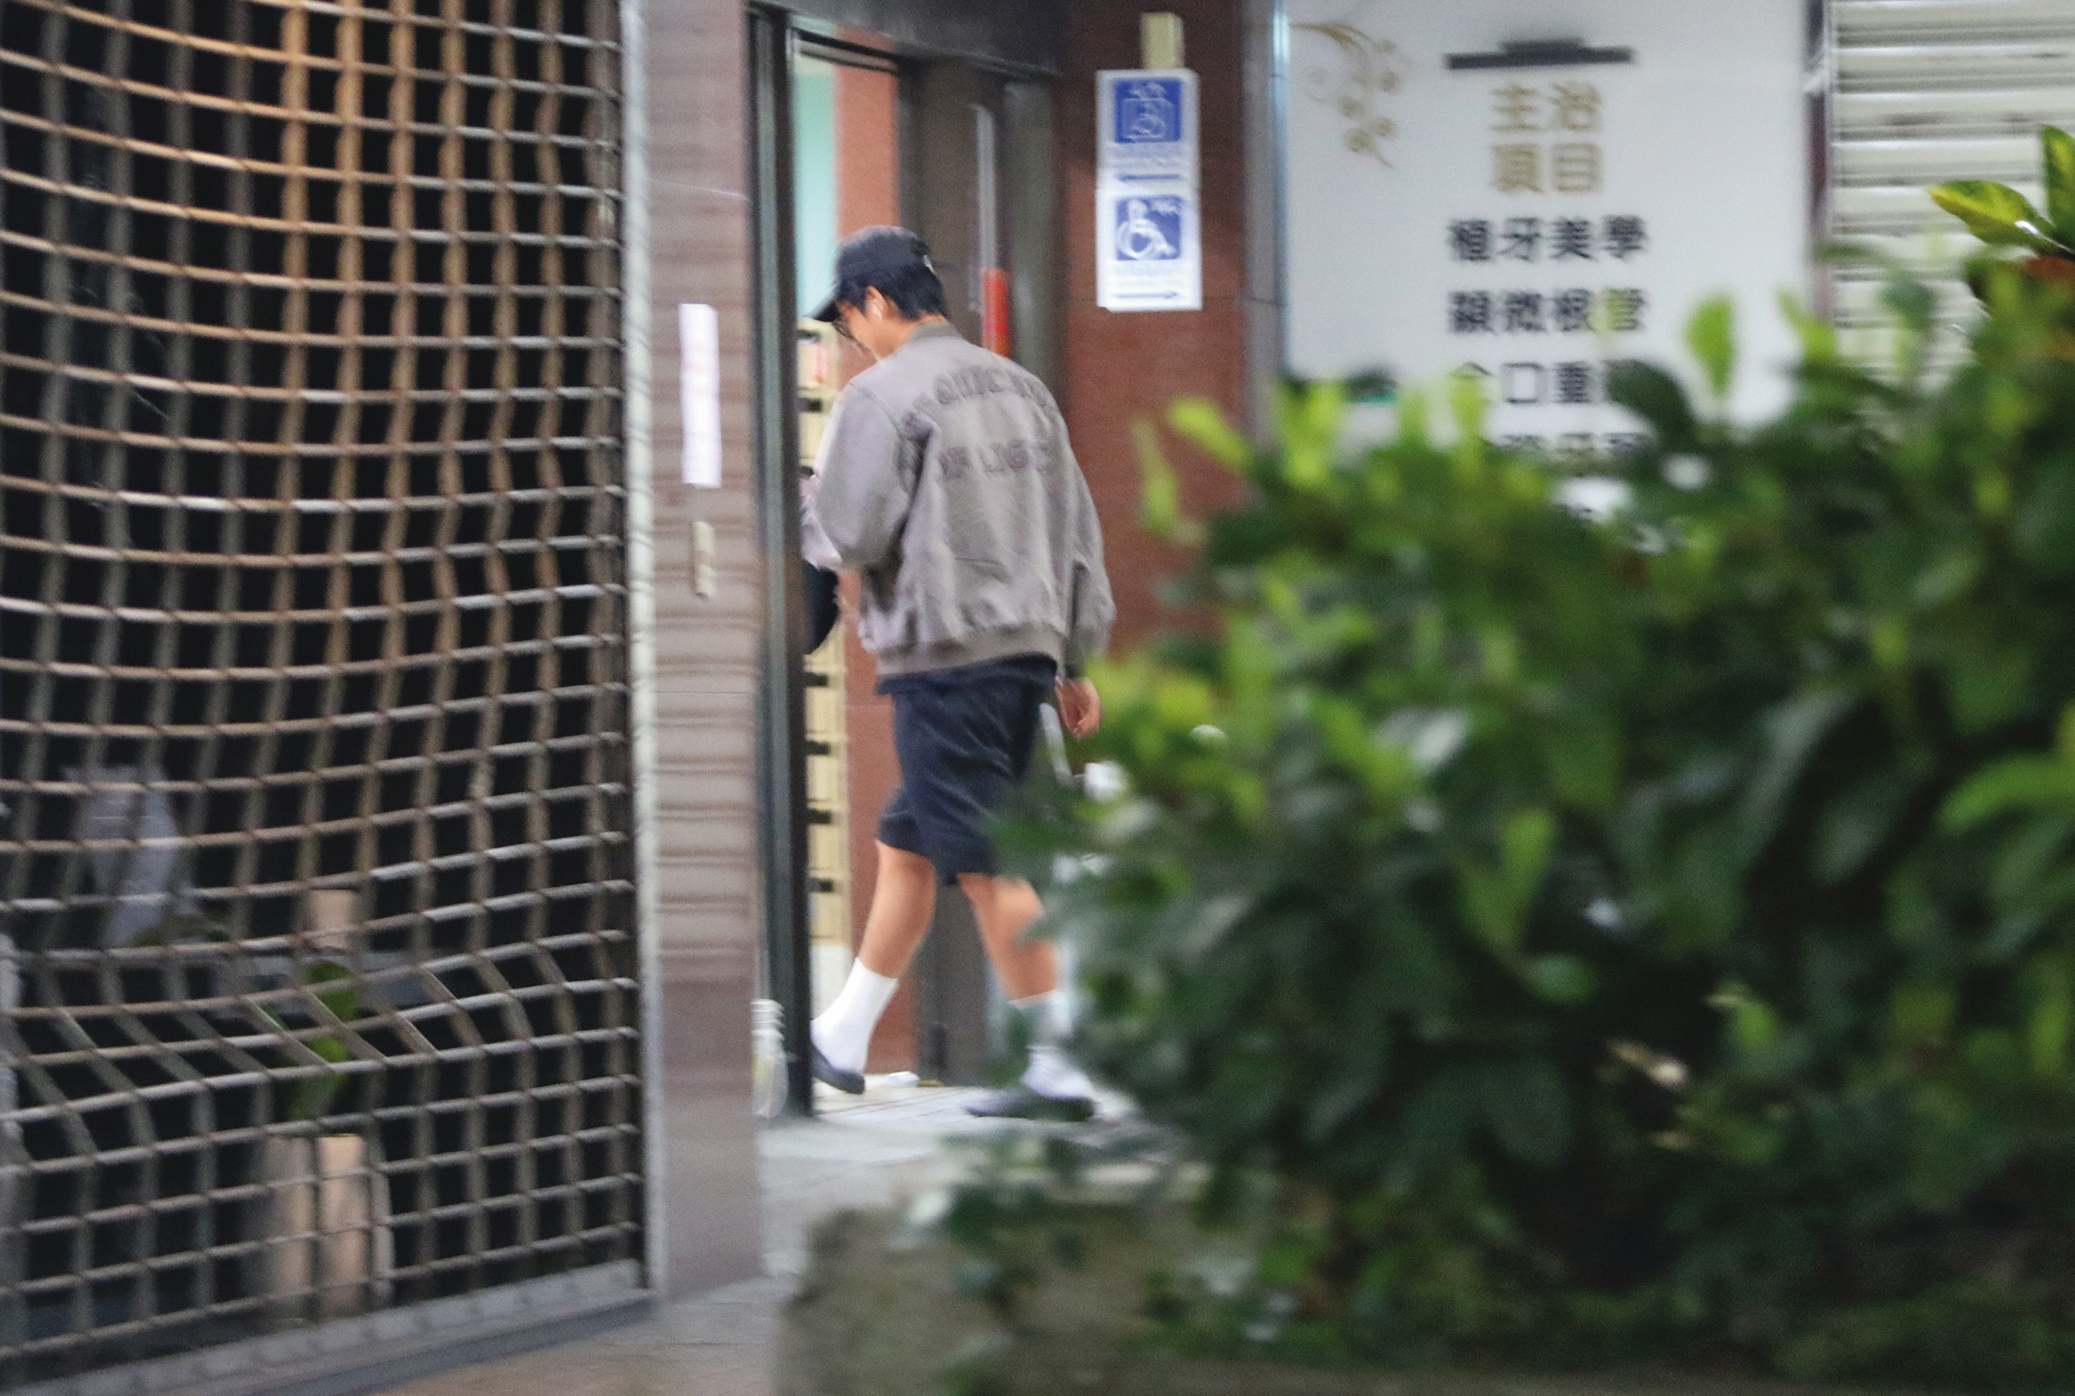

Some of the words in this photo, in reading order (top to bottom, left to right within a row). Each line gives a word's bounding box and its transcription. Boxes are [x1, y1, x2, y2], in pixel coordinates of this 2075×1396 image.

[1490, 80, 1602, 132] 主治
[1489, 142, 1603, 193] 項目
[1449, 215, 1645, 262] 植牙美學
